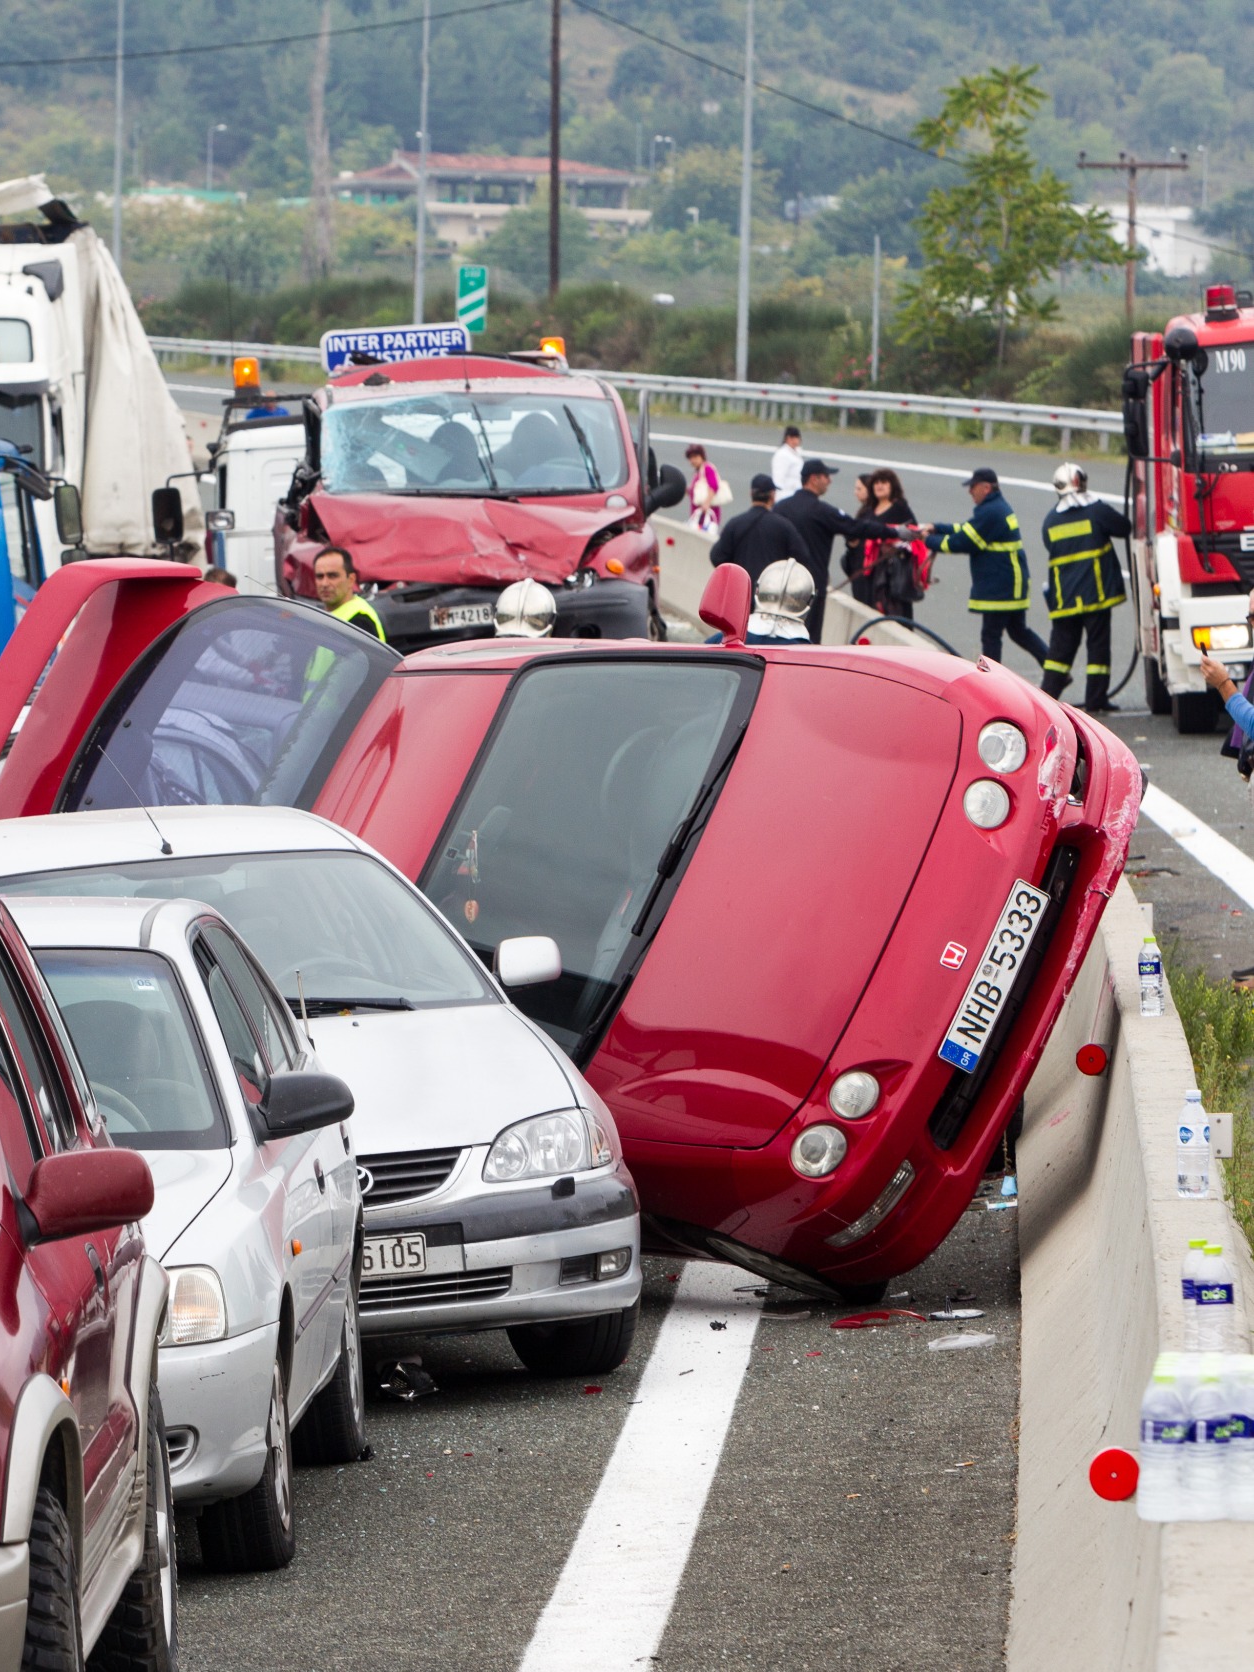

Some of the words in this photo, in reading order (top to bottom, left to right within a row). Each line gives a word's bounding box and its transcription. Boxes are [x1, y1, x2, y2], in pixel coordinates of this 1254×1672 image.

[327, 334, 380, 353] INTER
[382, 330, 464, 350] PARTNER
[1215, 348, 1246, 374] M90
[960, 1051, 973, 1067] GR
